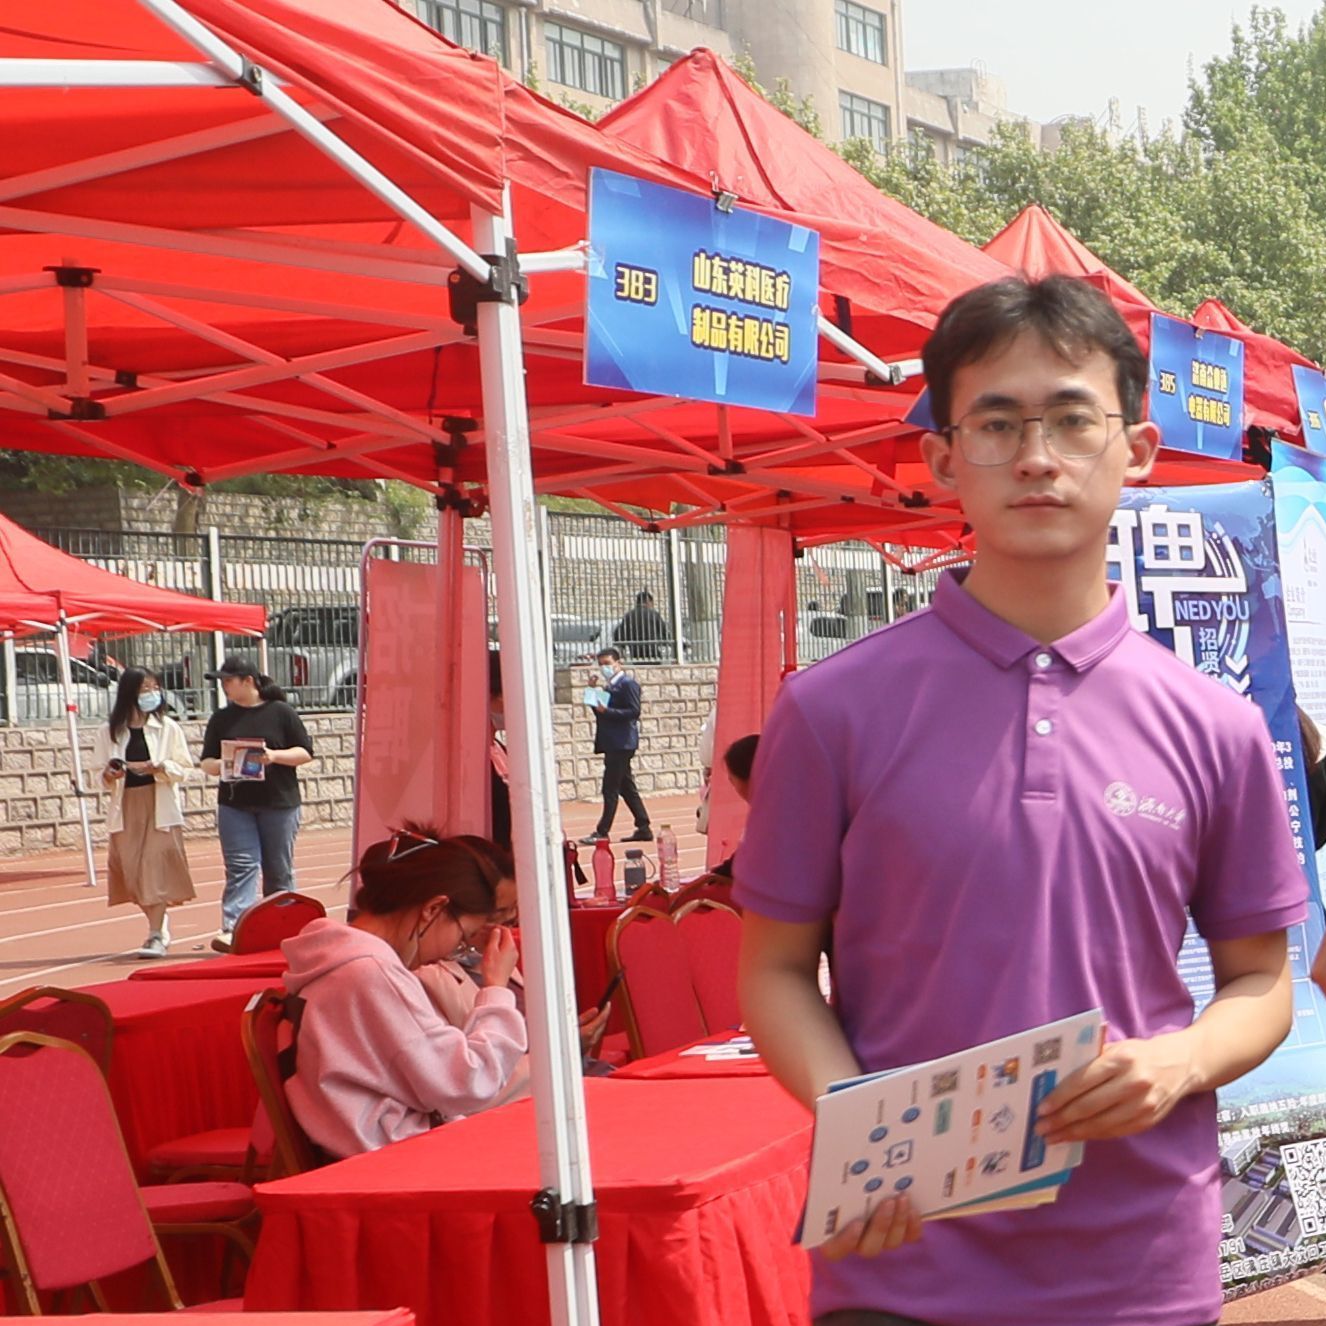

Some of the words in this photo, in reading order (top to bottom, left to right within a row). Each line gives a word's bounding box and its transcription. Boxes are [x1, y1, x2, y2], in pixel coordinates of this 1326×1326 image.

[615, 264, 658, 304] 383
[693, 250, 791, 310] 山东英科医疗
[692, 305, 790, 362] 制品有限公司
[1212, 600, 1249, 621] YOU
